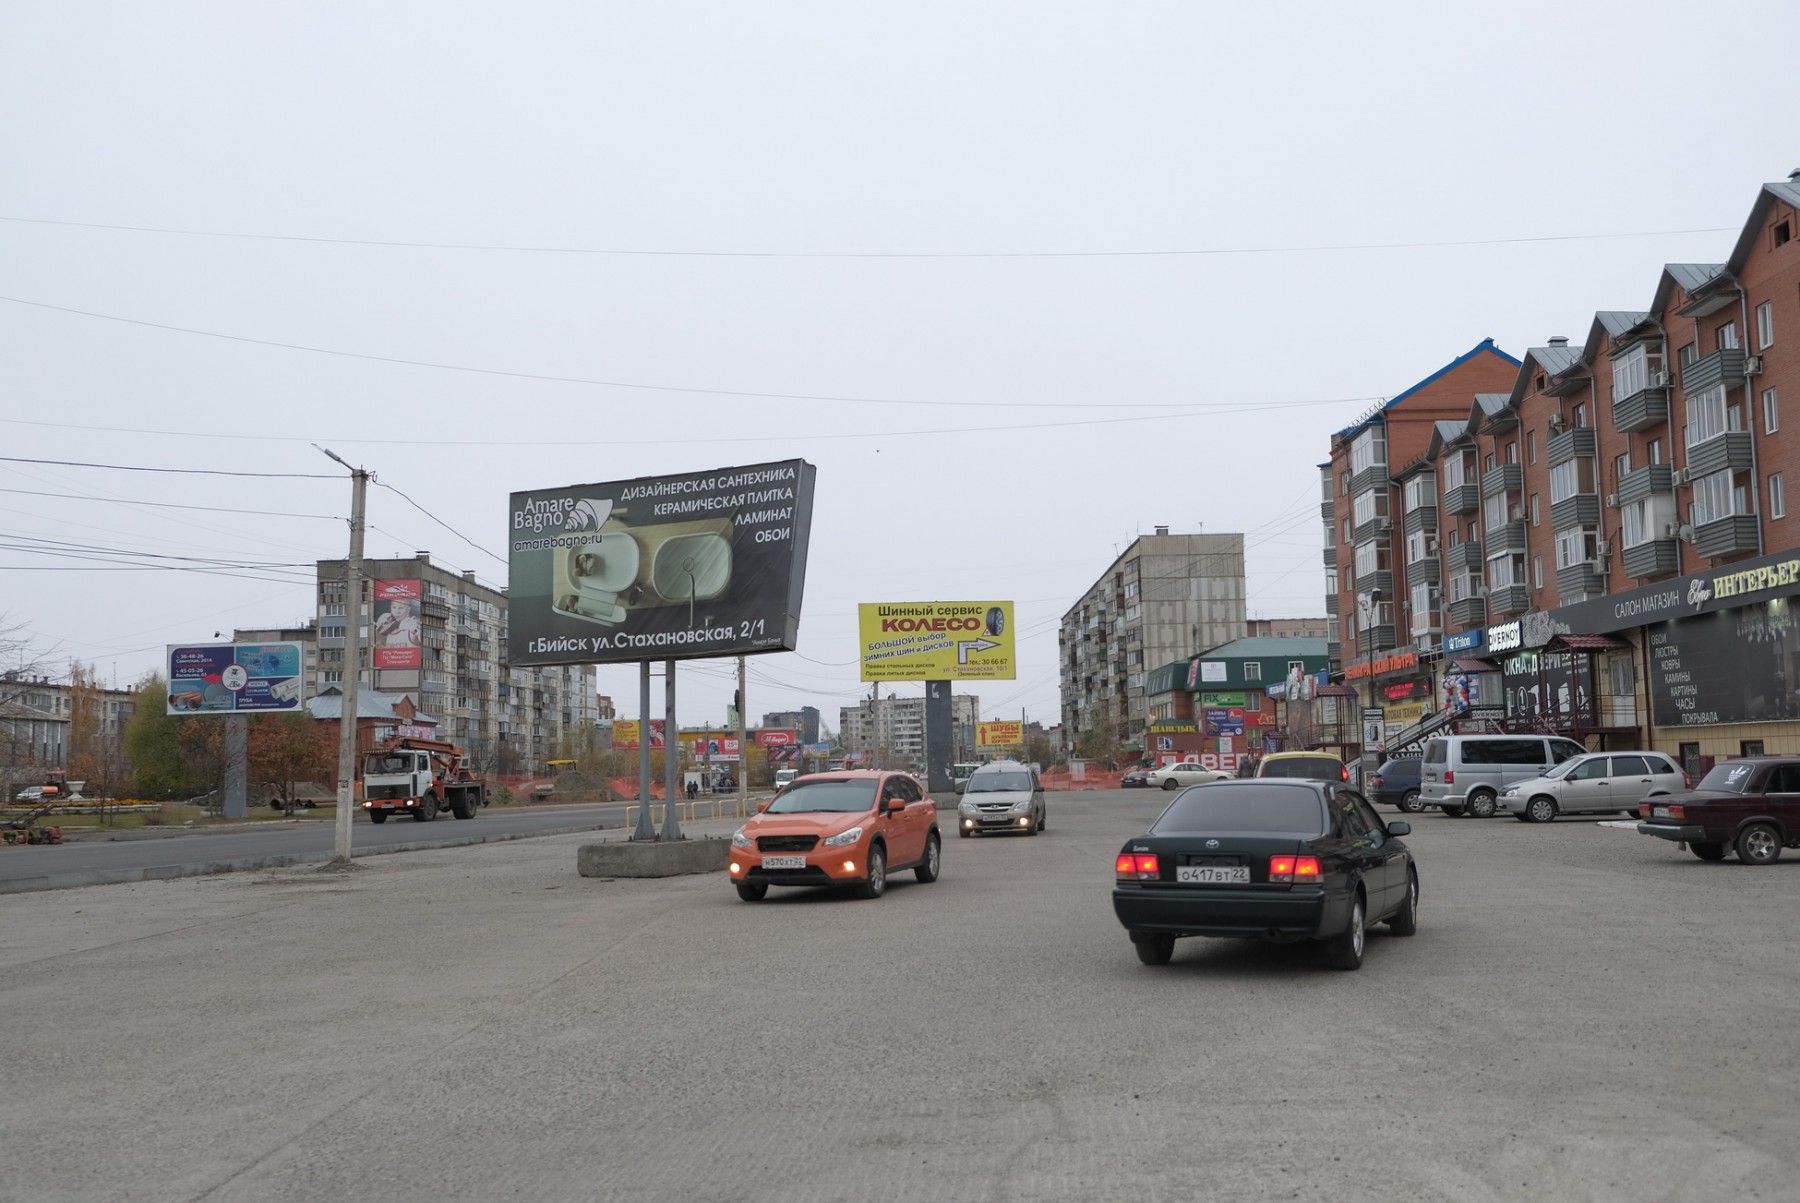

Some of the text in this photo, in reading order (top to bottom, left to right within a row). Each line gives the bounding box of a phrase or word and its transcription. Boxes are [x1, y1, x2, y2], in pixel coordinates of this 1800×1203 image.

[620, 467, 795, 502] ДИЗАЙНЕРСКАЯ САНТЕХНИКА
[524, 497, 574, 515] Amare
[653, 487, 793, 516] КЕРАМИЧЕСКАЯ ПЛИТКА
[514, 510, 563, 532] Bagno
[735, 507, 793, 526] ЛАМИНАТ
[514, 533, 603, 552] amarebagno.ru
[755, 528, 790, 544] ОБОИ
[1614, 602, 1641, 619] САЛОН
[1642, 590, 1680, 612] МАГАЗИН
[1713, 559, 1800, 599] ИНТЕРЬЕР
[878, 606, 983, 617] Шинный сервис
[881, 617, 981, 633] КОЛЕСО
[528, 636, 588, 654] г.Бийск
[740, 618, 765, 640] 2/1
[868, 632, 947, 651] БОЛЬШОЙ выбор
[1651, 634, 1667, 645] ОБОИ
[1654, 645, 1679, 658] ЛЮСТРЫ
[1503, 656, 1527, 676] ОКНА
[1661, 659, 1680, 671] КОВРЫ
[1664, 671, 1690, 683] КАМИНЫ
[1670, 684, 1697, 697] КАРТИНЫ
[1675, 698, 1695, 709] ЧАСЫ
[1681, 711, 1718, 724] ПОКРЫВАЛА
[1151, 725, 1196, 734] ШАШЛЫК
